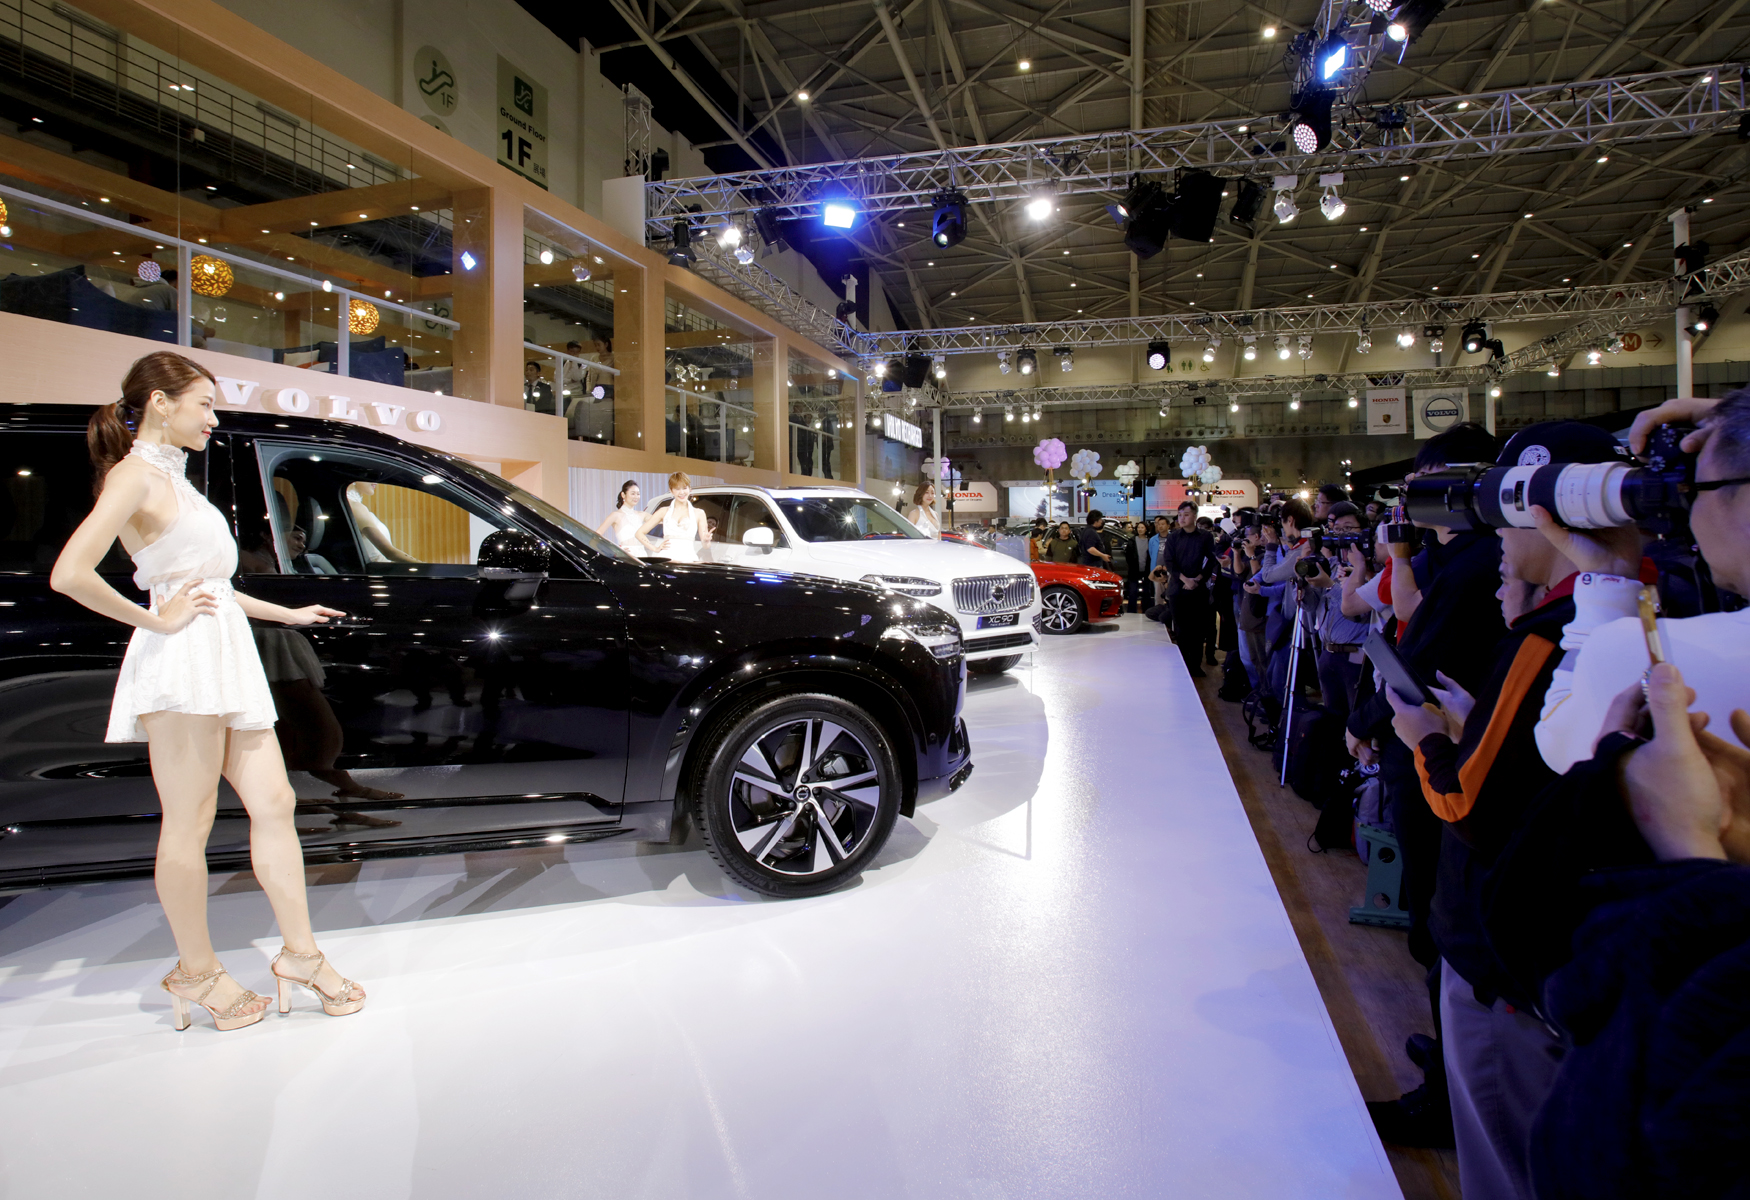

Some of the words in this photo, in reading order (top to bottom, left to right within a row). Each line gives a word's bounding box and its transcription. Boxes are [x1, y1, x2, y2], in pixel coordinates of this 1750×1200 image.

[440, 91, 454, 109] 1F
[500, 107, 526, 131] Ground
[528, 125, 546, 142] Floor
[502, 128, 532, 168] 1F
[1624, 335, 1638, 349] M
[215, 376, 441, 432] VOLVO
